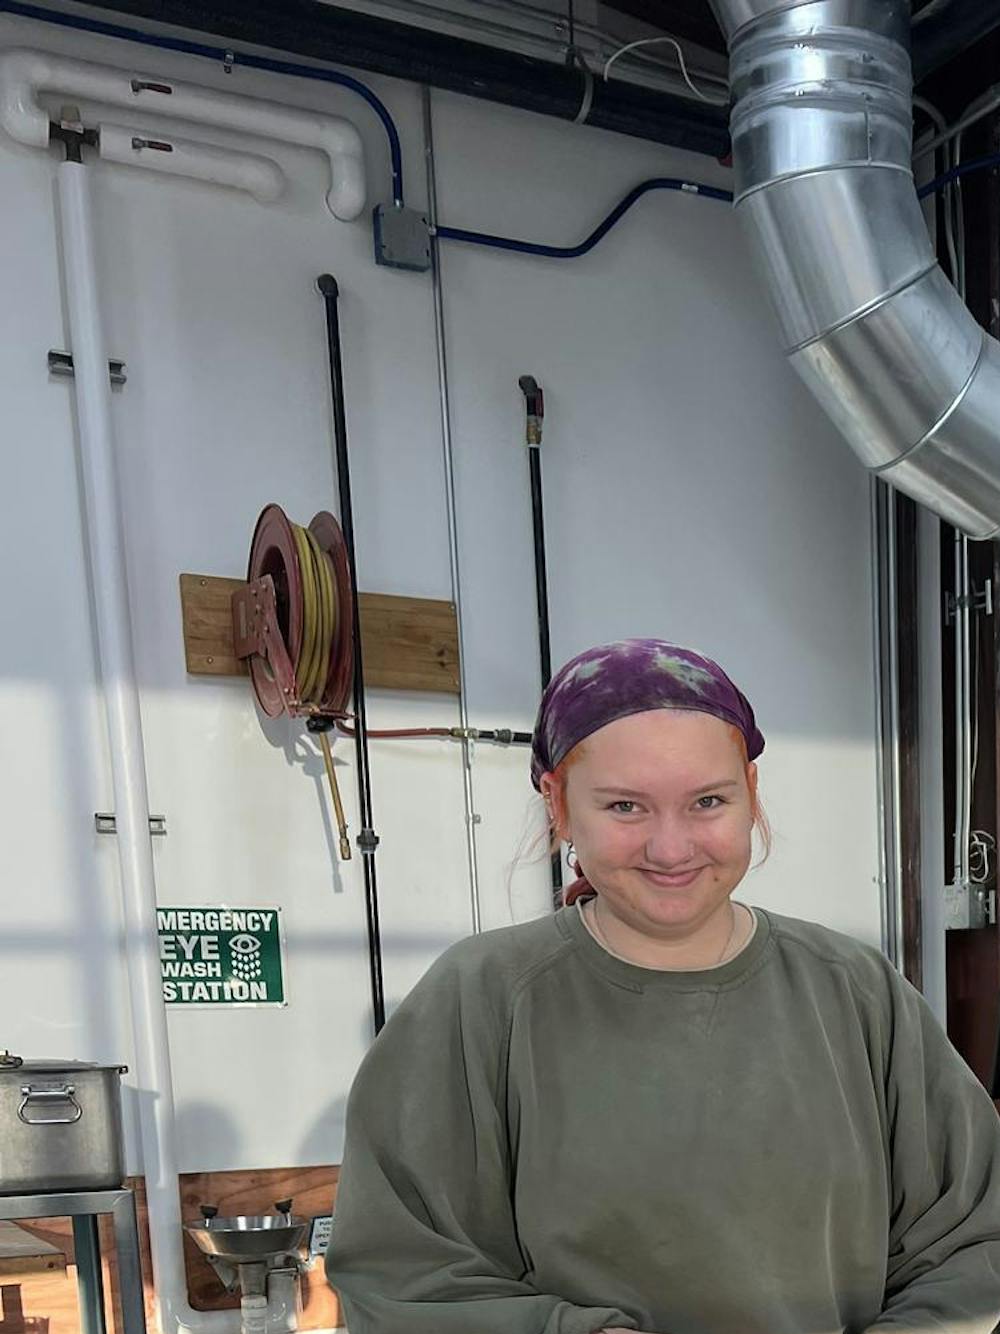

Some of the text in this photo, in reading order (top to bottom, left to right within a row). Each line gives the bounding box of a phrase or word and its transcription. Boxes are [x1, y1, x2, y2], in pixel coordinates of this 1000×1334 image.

[157, 911, 273, 932] MERGENCY
[158, 935, 220, 960] EYE
[161, 961, 222, 978] WASH
[163, 980, 268, 1001] STATION
